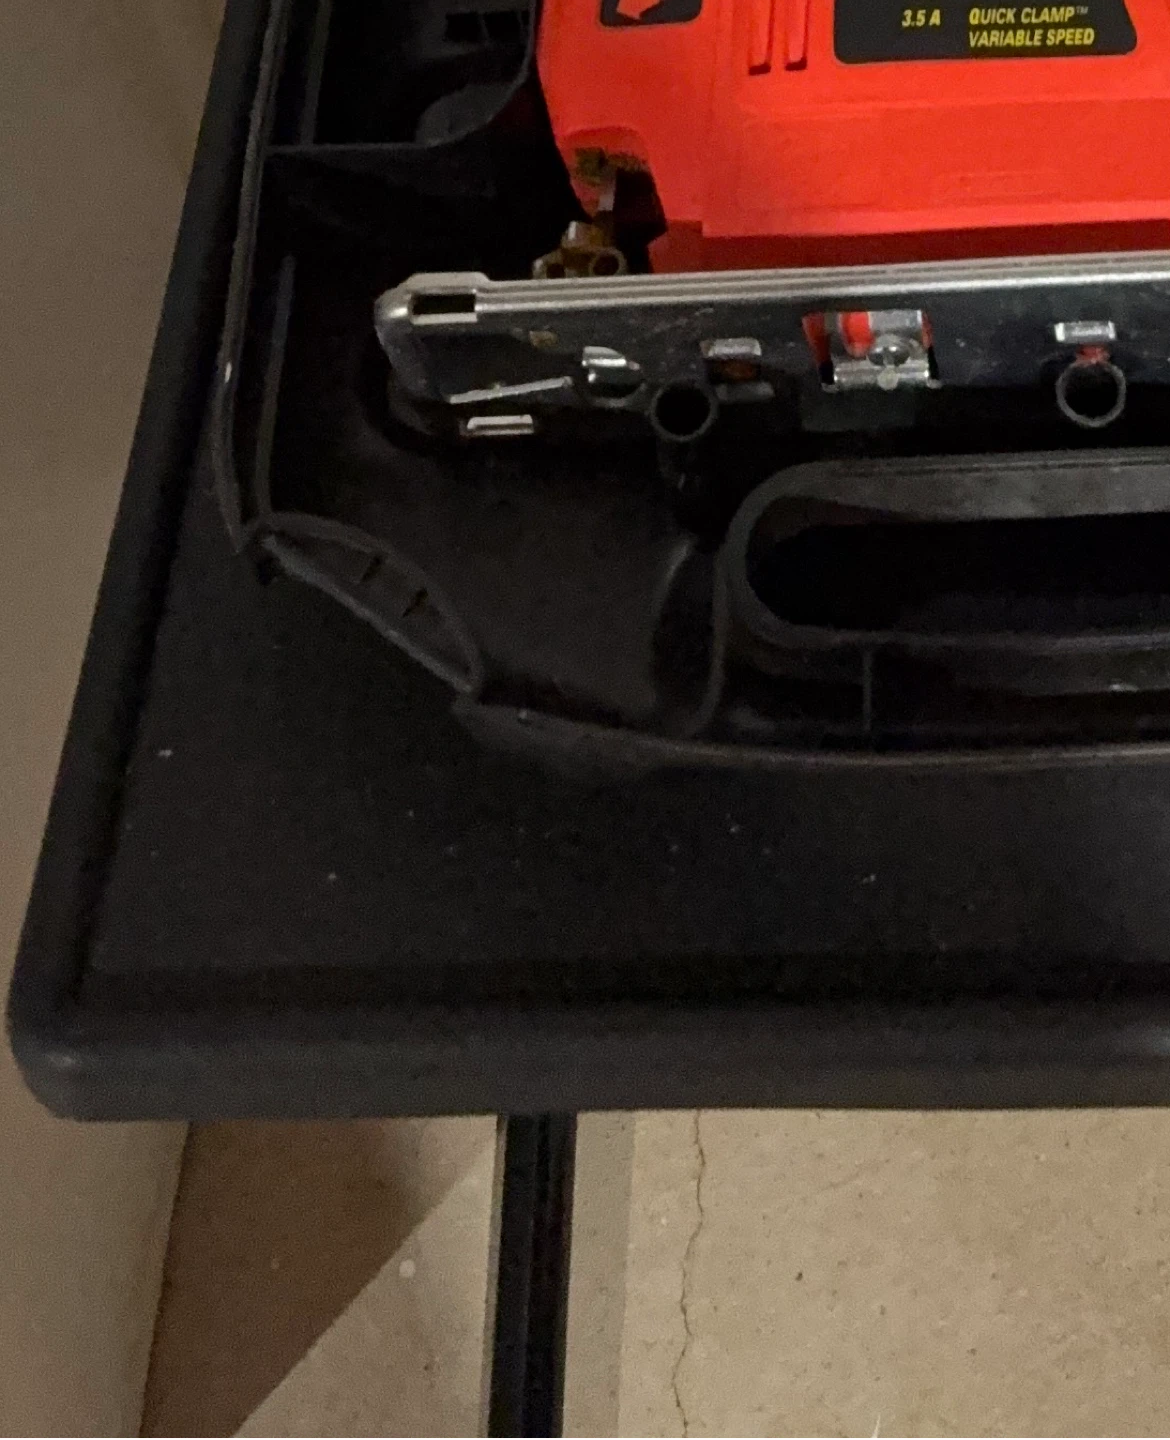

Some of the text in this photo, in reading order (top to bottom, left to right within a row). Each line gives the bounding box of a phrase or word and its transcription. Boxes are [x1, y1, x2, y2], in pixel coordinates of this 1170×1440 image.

[902, 9, 941, 27] 3.5 A
[969, 7, 1015, 25] QUICK
[969, 28, 1095, 47] VARIABLE SPEED
